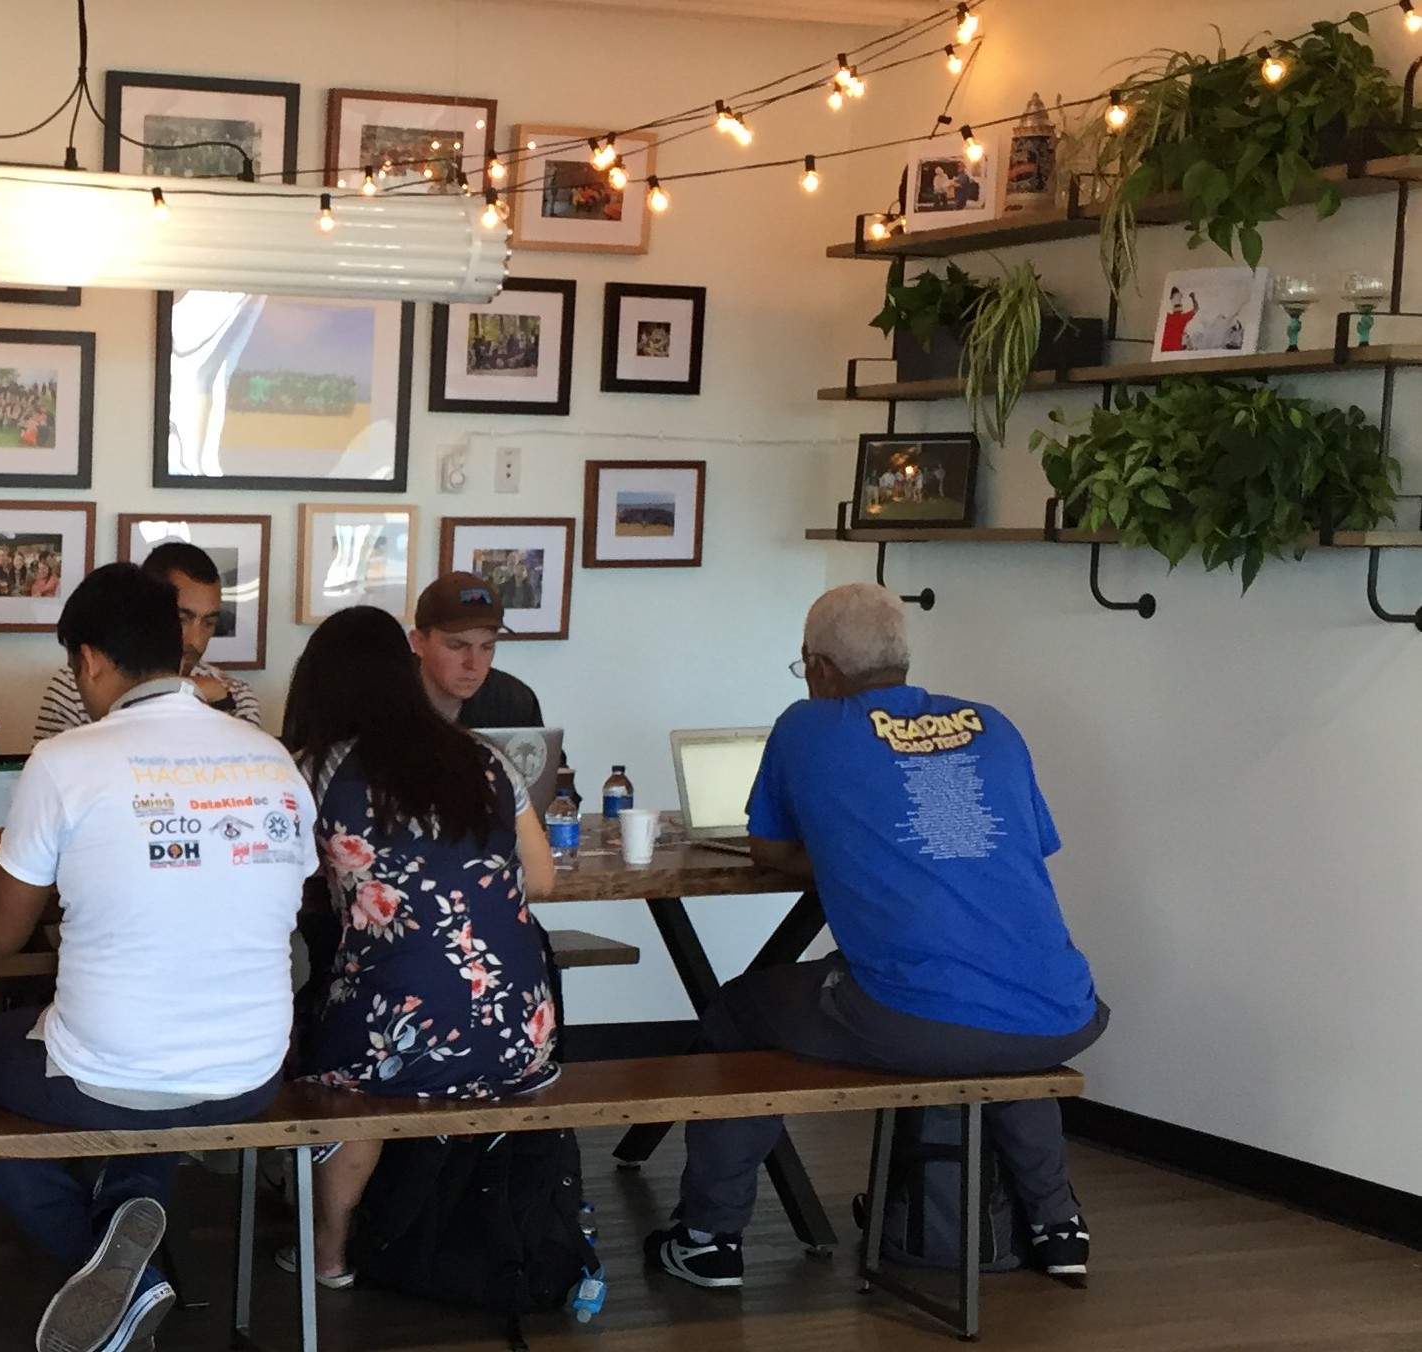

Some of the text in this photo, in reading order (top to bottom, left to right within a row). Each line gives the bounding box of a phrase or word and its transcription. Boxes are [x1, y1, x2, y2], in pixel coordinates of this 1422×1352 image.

[870, 708, 983, 740] READING
[174, 756, 197, 765] and
[149, 816, 202, 835] octo
[149, 842, 201, 861] DOH
